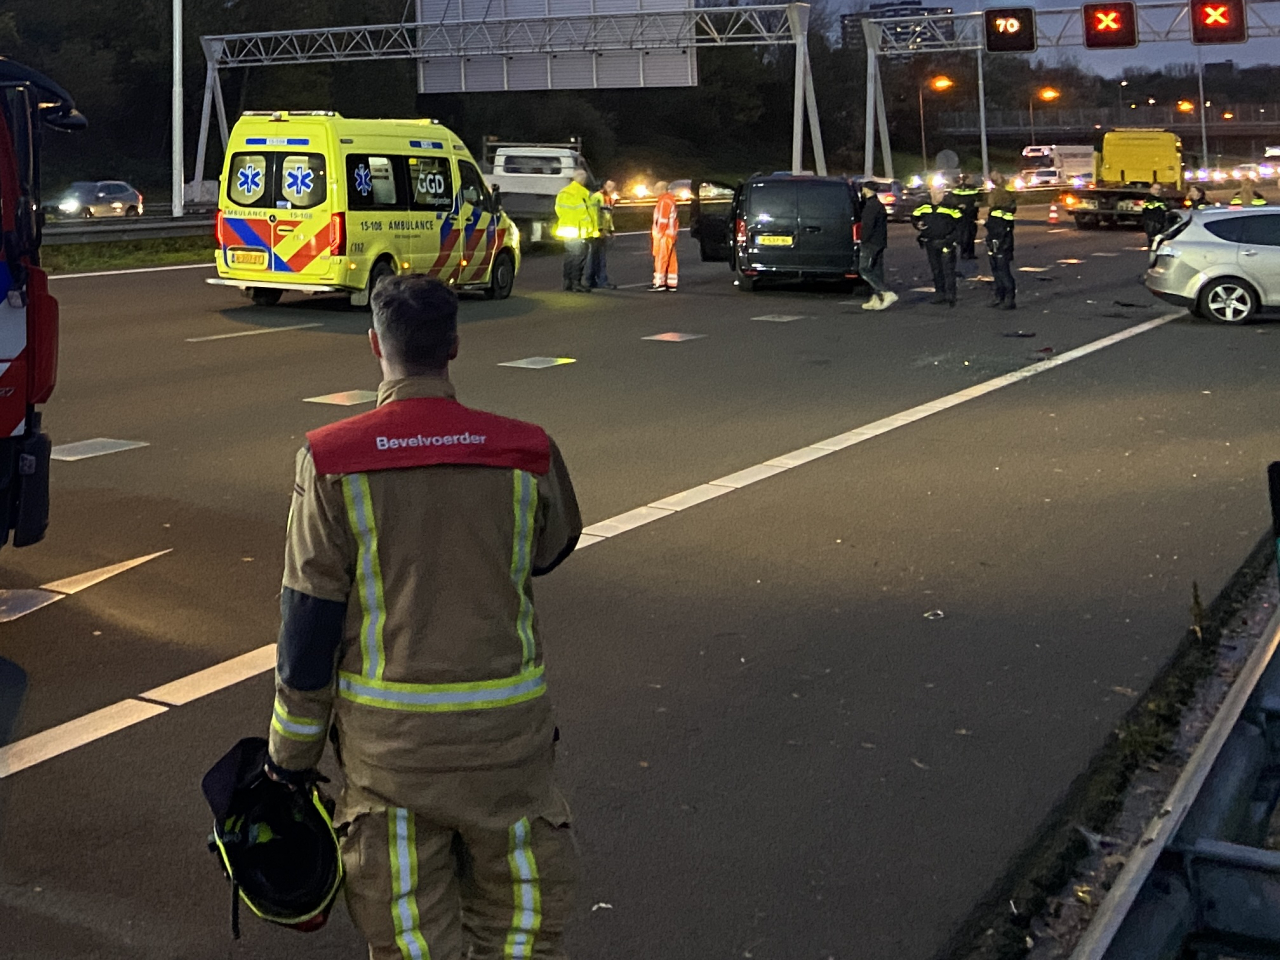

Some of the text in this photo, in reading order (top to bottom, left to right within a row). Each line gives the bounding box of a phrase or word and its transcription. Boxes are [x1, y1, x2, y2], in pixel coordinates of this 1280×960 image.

[995, 17, 1020, 33] 70
[418, 172, 445, 194] GGD
[223, 209, 267, 217] AMBULANCE
[360, 220, 434, 231] 15-108 AMBULANCE
[355, 243, 364, 252] 112
[376, 432, 487, 450] Bevelvoerder
